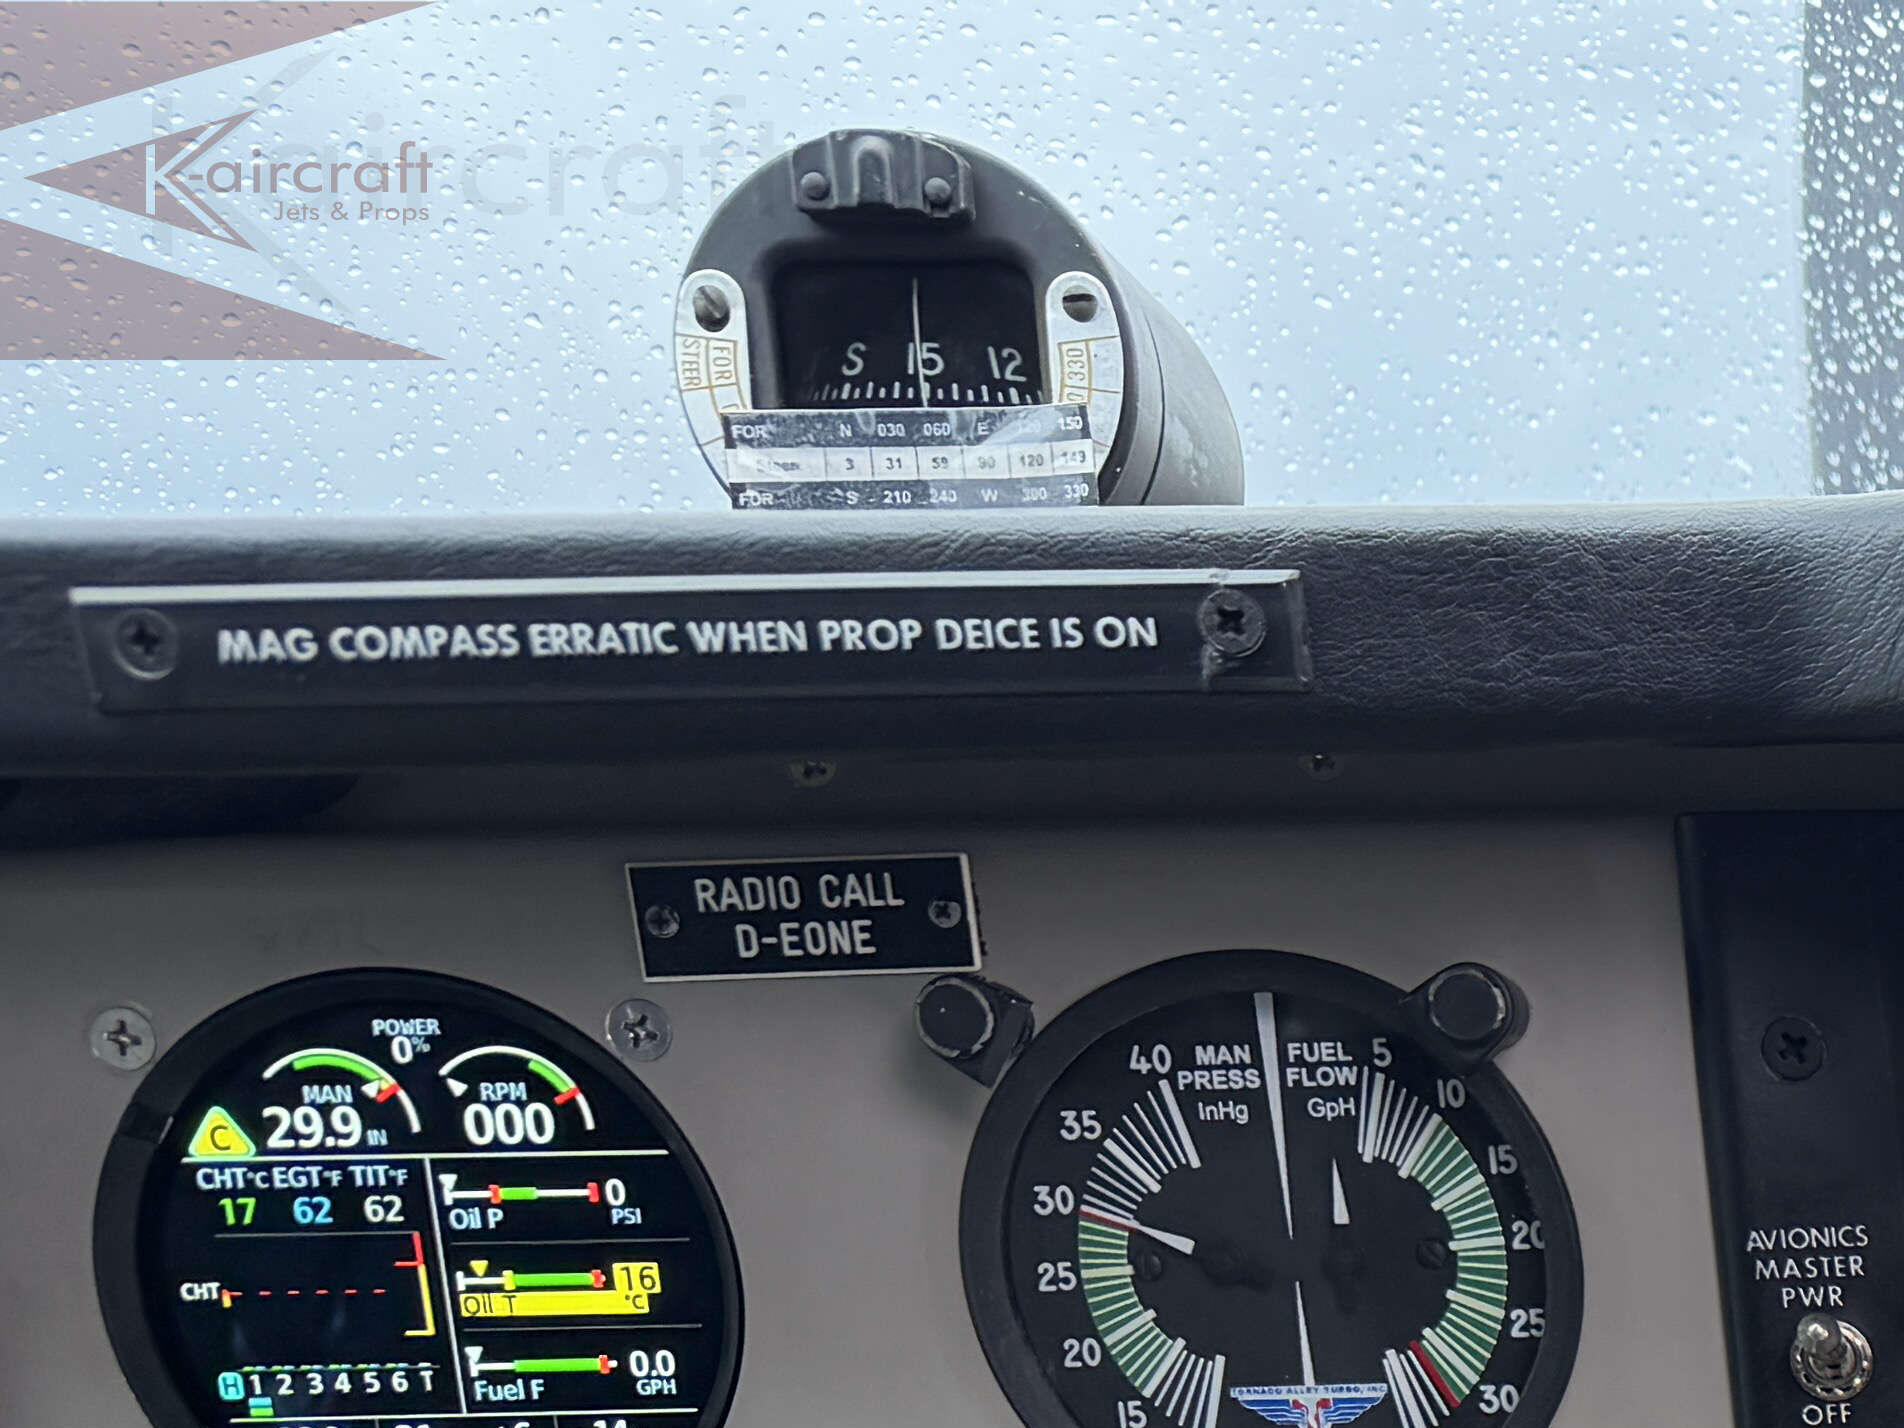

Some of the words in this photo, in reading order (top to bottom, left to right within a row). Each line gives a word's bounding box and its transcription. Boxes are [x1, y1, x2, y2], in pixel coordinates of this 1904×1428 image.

[680, 337, 701, 389] STEER
[842, 342, 866, 376] S
[907, 342, 944, 376] 15
[987, 346, 1026, 382] 12
[1066, 348, 1084, 381] 330
[219, 627, 316, 663] MAG
[329, 624, 518, 661] COMPASS
[529, 621, 677, 657] ERRATIC
[689, 619, 806, 654] WHEN
[819, 618, 922, 652] PROP
[937, 618, 1039, 650] DEICE
[1052, 618, 1083, 648] IS
[1096, 617, 1156, 648] ON
[696, 876, 801, 913] RADIO
[819, 874, 903, 909] CALL
[736, 921, 875, 958] D-EONE
[372, 1018, 441, 1037] POWER
[1195, 1045, 1250, 1066] MAN
[1288, 1043, 1352, 1064] FUEL
[480, 1082, 526, 1101] RPM
[1178, 1070, 1261, 1091] PRESS
[1286, 1066, 1359, 1087] FLOW
[303, 1085, 353, 1104] MAN
[465, 1103, 555, 1145] 000
[1198, 1100, 1249, 1125] InHg
[1308, 1097, 1356, 1120] GpH
[263, 1105, 362, 1149] 29.9
[367, 1129, 388, 1147] IN
[219, 1197, 256, 1226] 17
[448, 1208, 482, 1230] Oil
[488, 1209, 504, 1229] P
[1747, 1225, 1869, 1252] AVIONICS
[620, 1265, 656, 1292] 16
[1756, 1254, 1865, 1280] MASTER
[1782, 1286, 1844, 1309] PWR
[474, 1380, 526, 1401] Fuel
[531, 1379, 544, 1399] F
